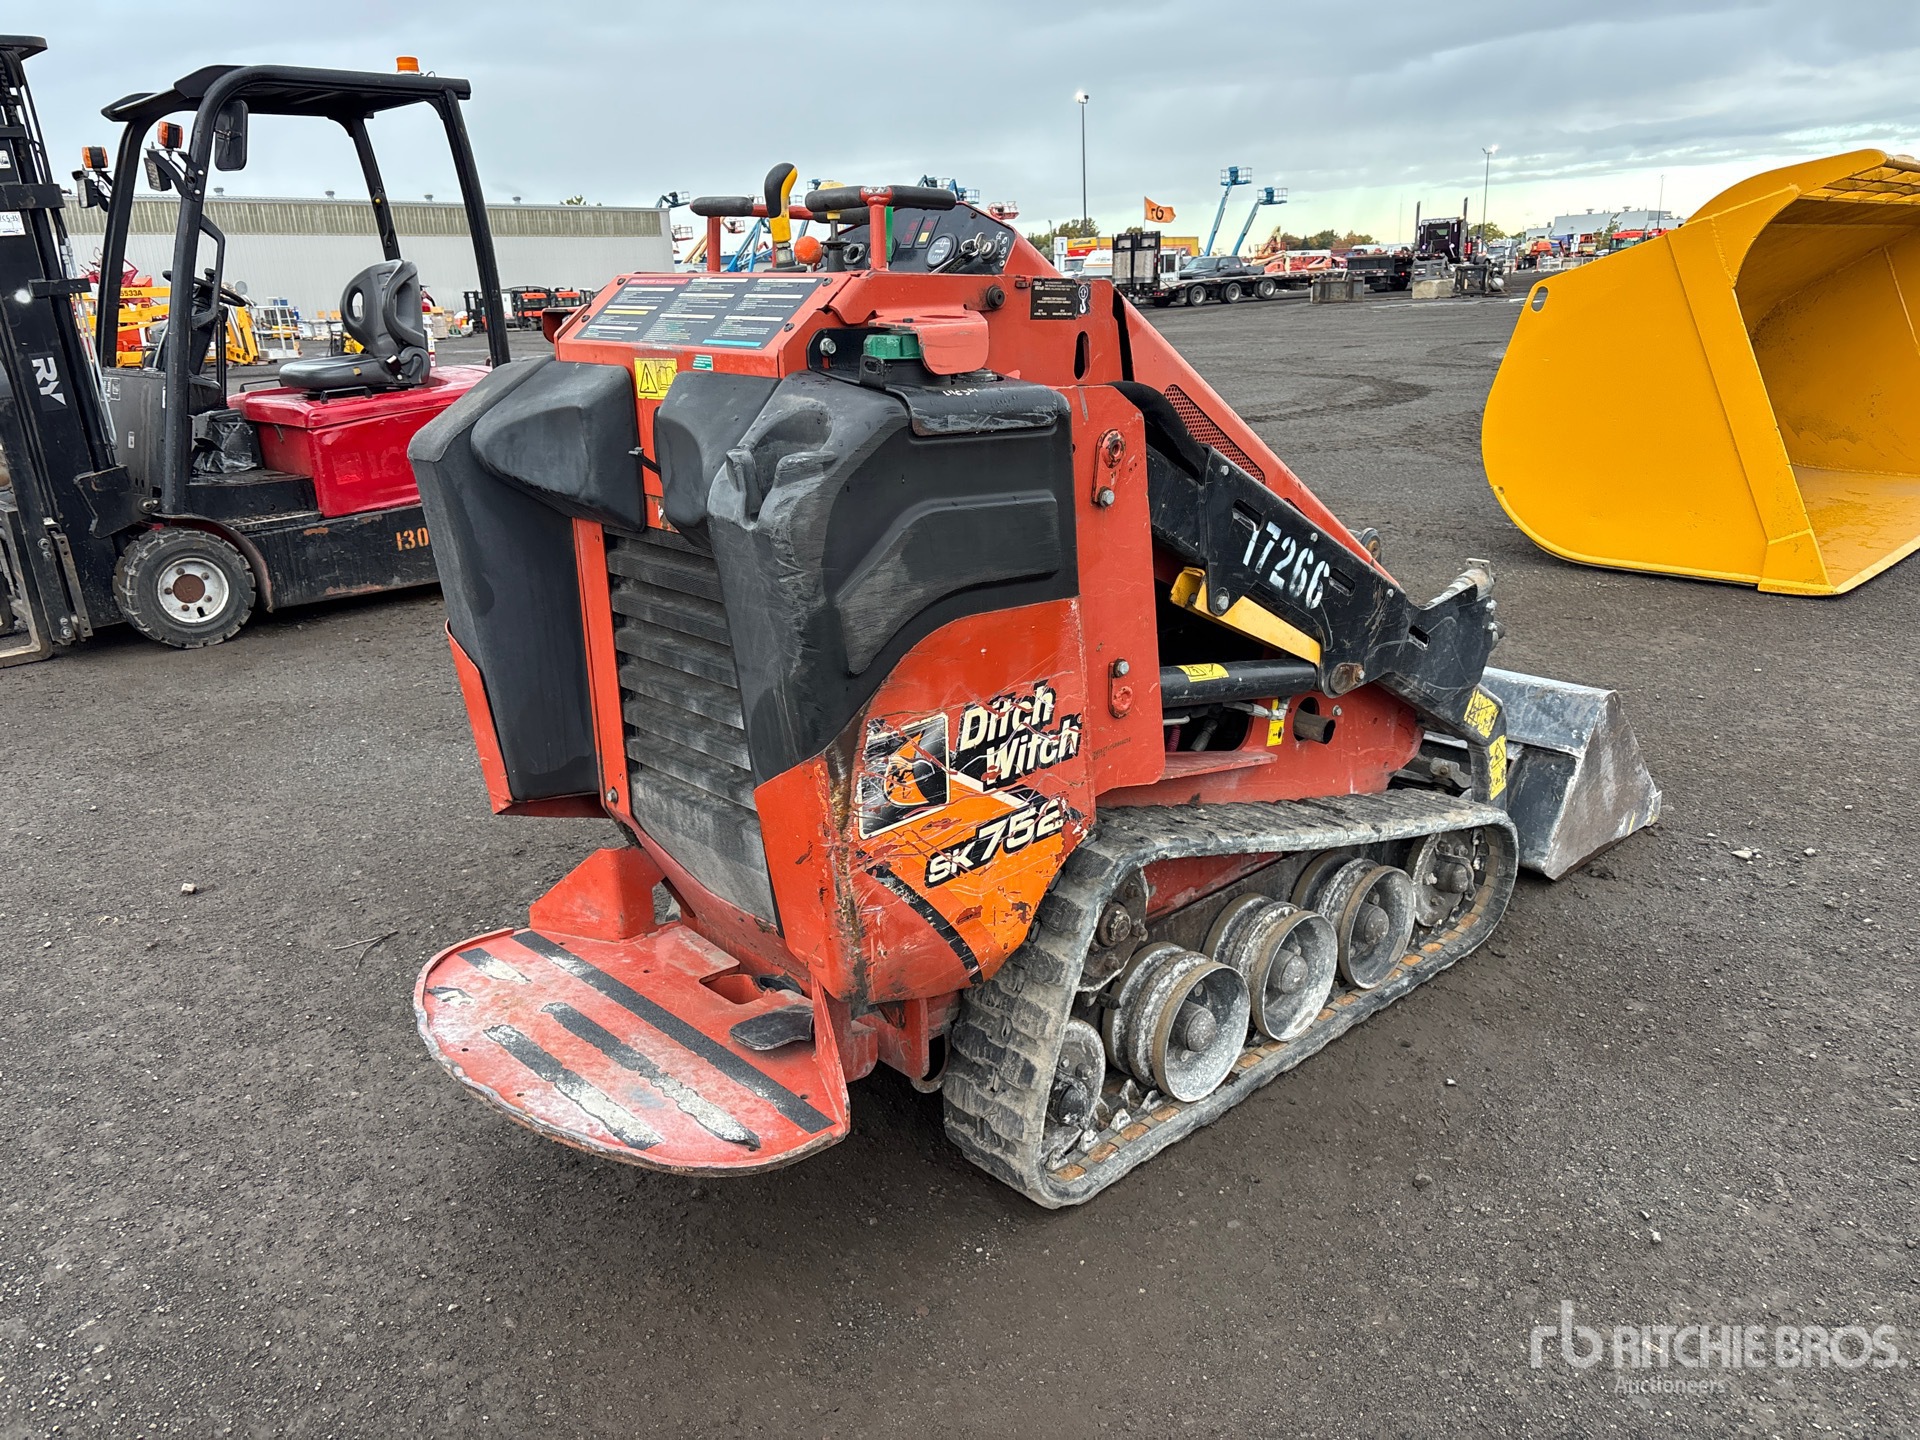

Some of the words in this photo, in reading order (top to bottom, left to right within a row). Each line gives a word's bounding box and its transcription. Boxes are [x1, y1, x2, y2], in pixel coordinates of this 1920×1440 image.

[31, 356, 67, 406] RY
[395, 526, 430, 552] 130
[1242, 521, 1330, 610] 17266
[958, 684, 1055, 752] Ditch
[985, 720, 1080, 785] Witch
